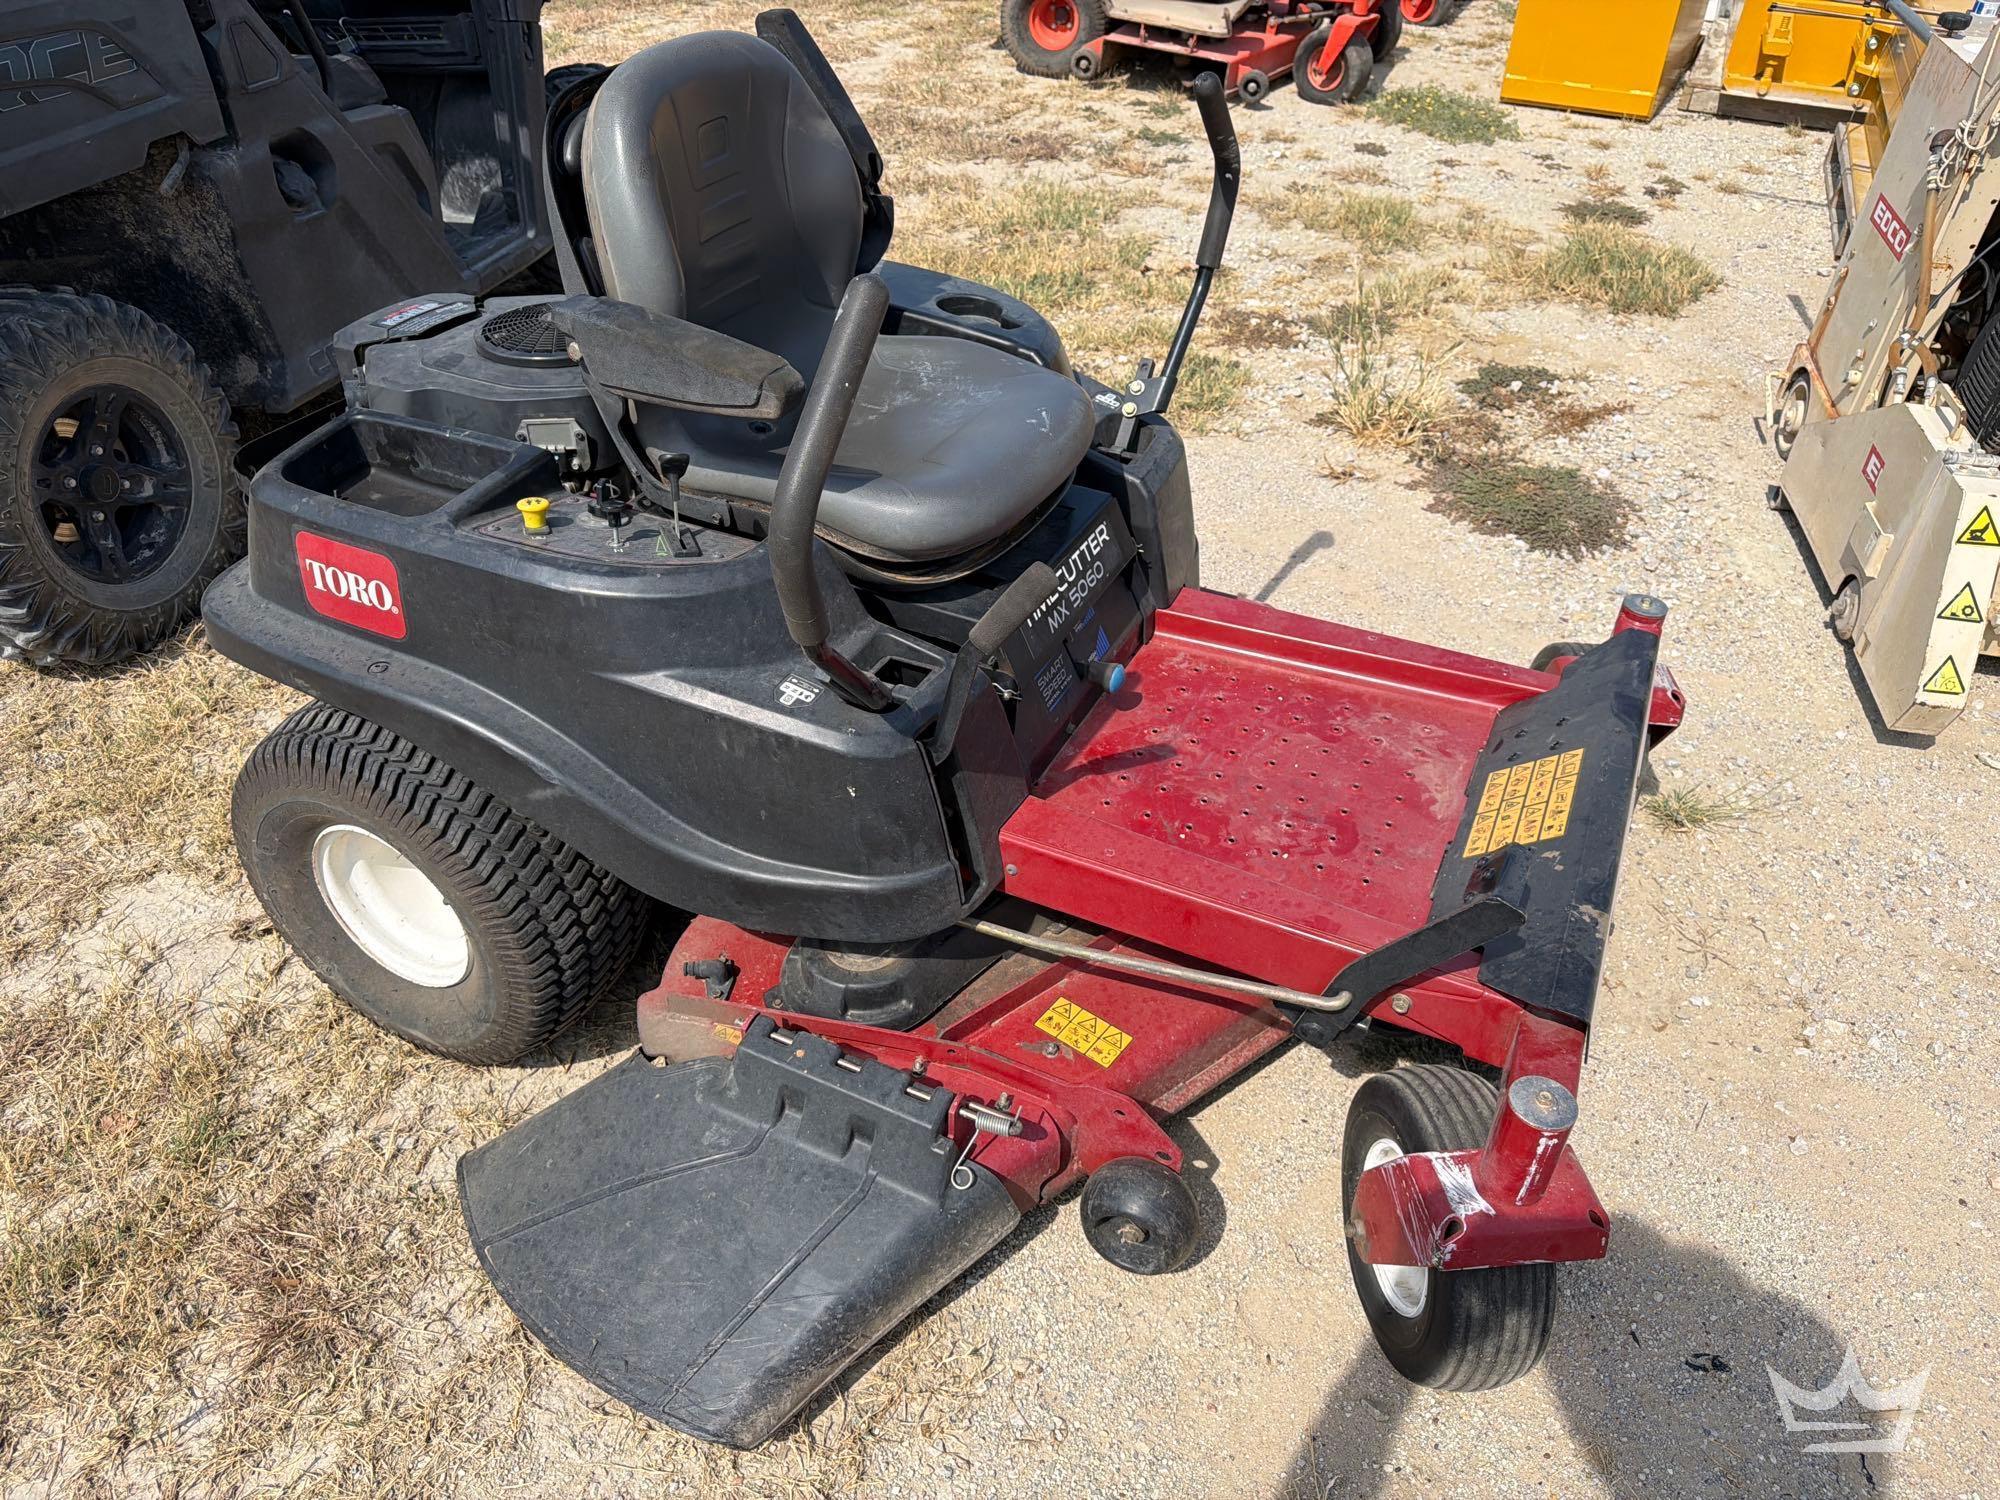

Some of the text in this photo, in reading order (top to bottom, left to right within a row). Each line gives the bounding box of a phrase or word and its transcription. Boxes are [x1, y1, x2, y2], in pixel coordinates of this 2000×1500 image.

[1873, 201, 1907, 254] EDCO
[304, 558, 393, 612] TORO
[1047, 599, 1070, 634] MX
[1068, 560, 1104, 608] 5060
[1037, 653, 1065, 692] SMART
[1042, 667, 1068, 702] SPEED
